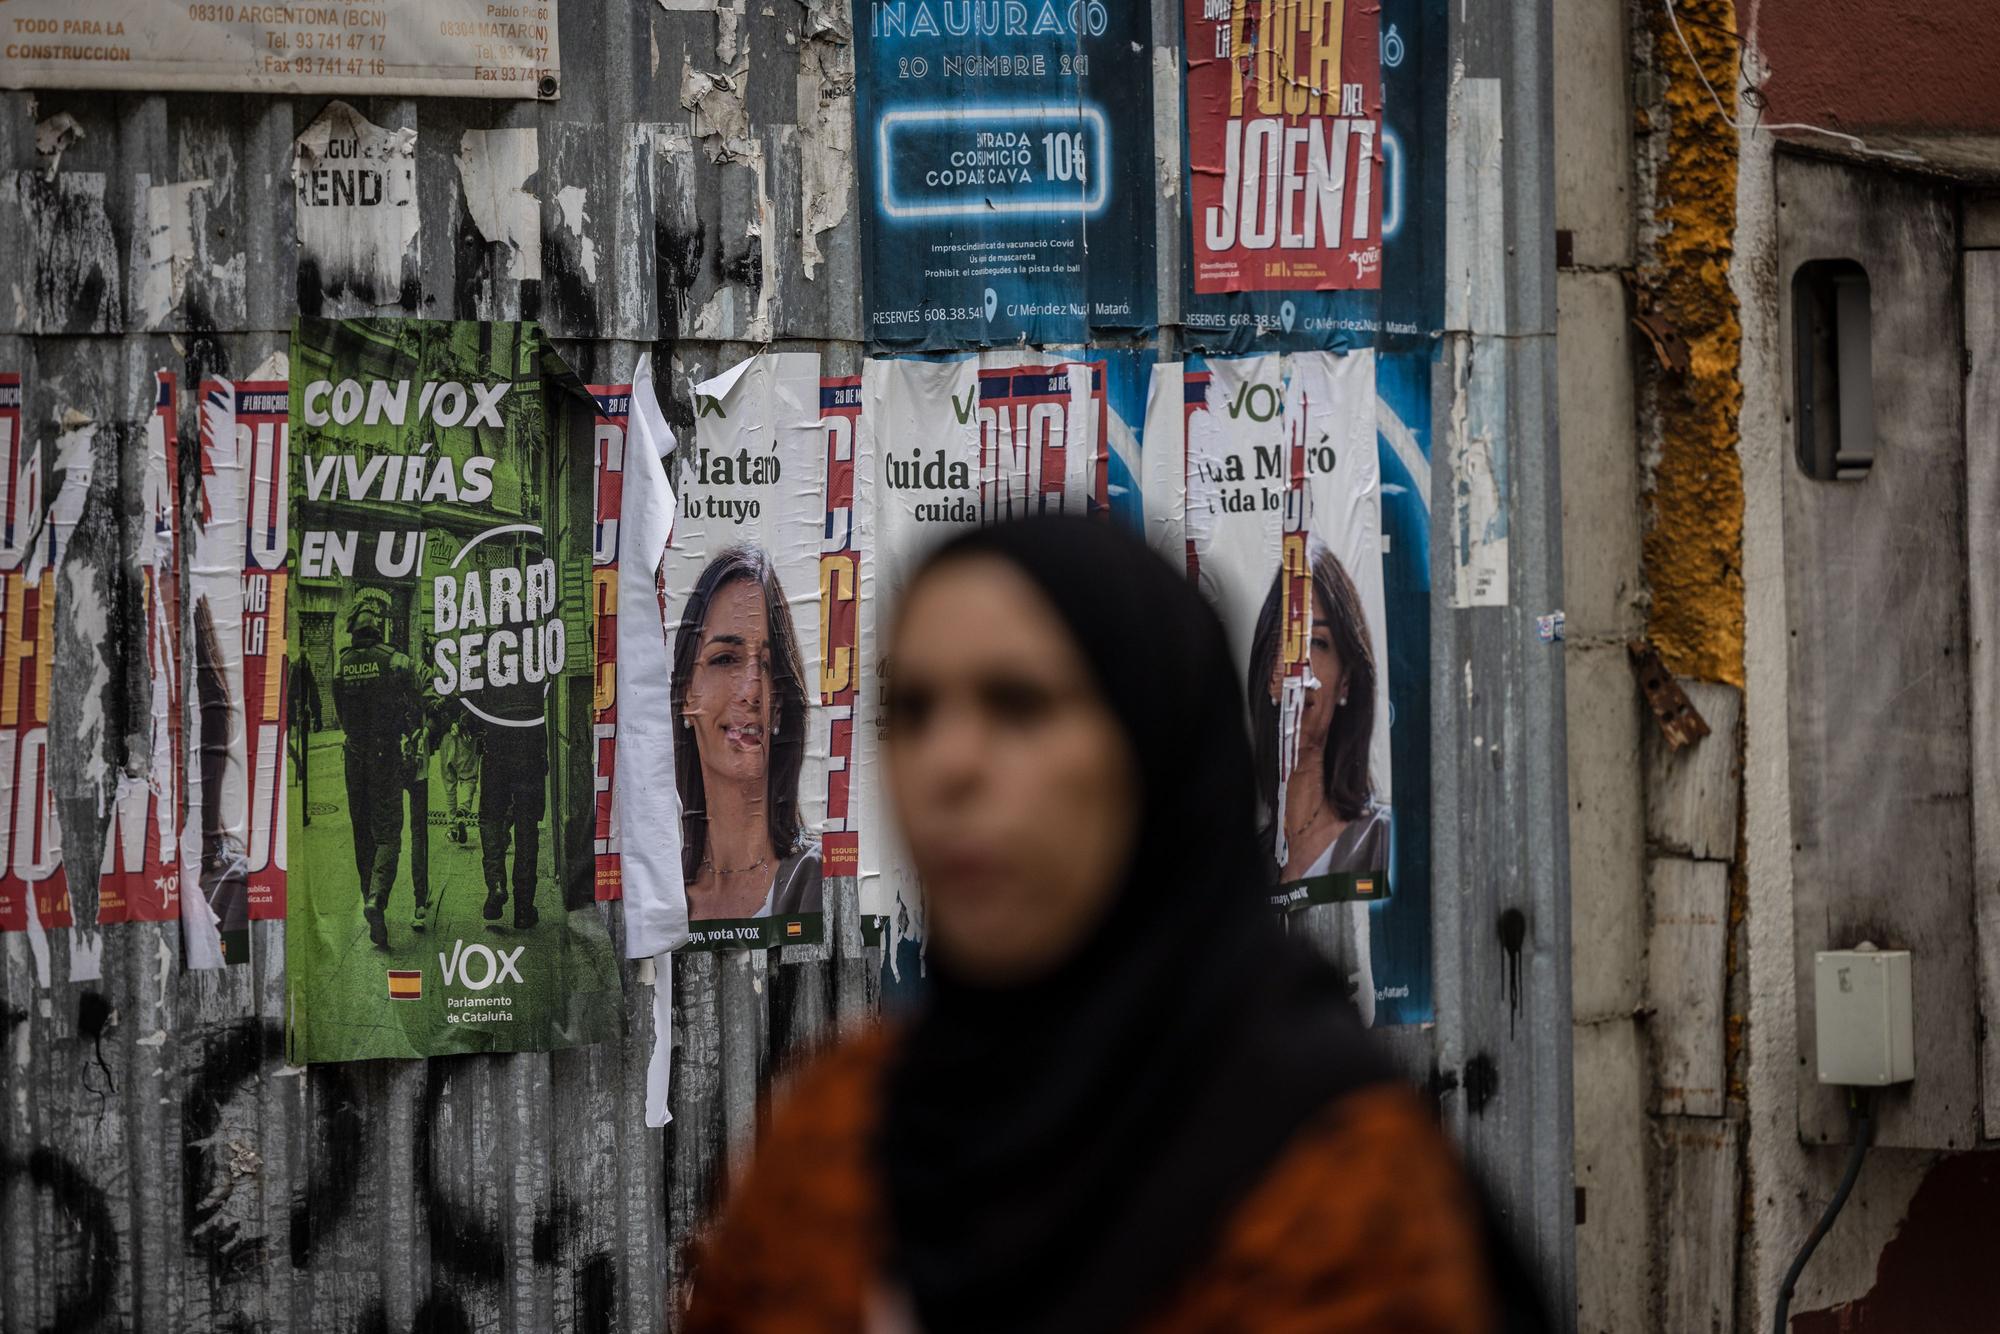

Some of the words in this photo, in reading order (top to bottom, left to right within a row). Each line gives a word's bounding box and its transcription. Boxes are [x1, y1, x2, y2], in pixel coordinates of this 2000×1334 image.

[189, 5, 234, 22] 08310
[238, 6, 338, 25] ARGENTONA
[343, 10, 387, 28] (BCN)
[487, 5, 519, 17] Pablo
[14, 18, 58, 33] TODO
[63, 20, 101, 35] PARA
[106, 21, 125, 35] LA
[266, 32, 290, 48] Tel.
[296, 33, 313, 48] 93
[318, 33, 341, 49] 741
[347, 34, 363, 49] 47
[370, 35, 386, 50] 17
[1215, 24, 1230, 58] LA
[6, 43, 130, 61] CONSTRUCCIÓN
[265, 56, 290, 73] Fax
[295, 57, 312, 73] 93
[318, 57, 341, 74] 741
[347, 58, 363, 75] 47
[370, 59, 385, 75] 16
[475, 66, 497, 81] Fax
[501, 67, 516, 81] 93
[899, 57, 928, 78] 20
[926, 170, 977, 186] COPA
[988, 168, 1032, 184] CAVA
[1205, 118, 1376, 251] JOENT
[1006, 240, 1048, 249] vacunació
[1050, 240, 1074, 248] Covid
[925, 269, 960, 278] Prohibit
[1019, 265, 1027, 273] la
[1028, 264, 1050, 274] pista
[1052, 264, 1065, 272] de
[873, 311, 919, 324] RESERVES
[924, 306, 983, 322] 608.38.54
[1020, 303, 1067, 317] Méndez
[304, 378, 410, 427] CON
[608, 399, 618, 412] 28
[619, 398, 628, 412] DE
[835, 390, 844, 404] 28
[846, 390, 855, 404] DE
[885, 448, 969, 490] Cuida
[1261, 487, 1279, 511] lo
[683, 493, 700, 519] lo
[706, 495, 760, 525] tuyo
[915, 496, 977, 522] cuida
[300, 531, 359, 577] EN
[688, 932, 706, 944] ayo,
[708, 928, 734, 940] vota
[735, 927, 760, 940] VOX
[439, 939, 525, 990] VOX
[447, 996, 512, 1008] Parlamento
[447, 1013, 460, 1023] de
[462, 1011, 513, 1022] Cataluña
